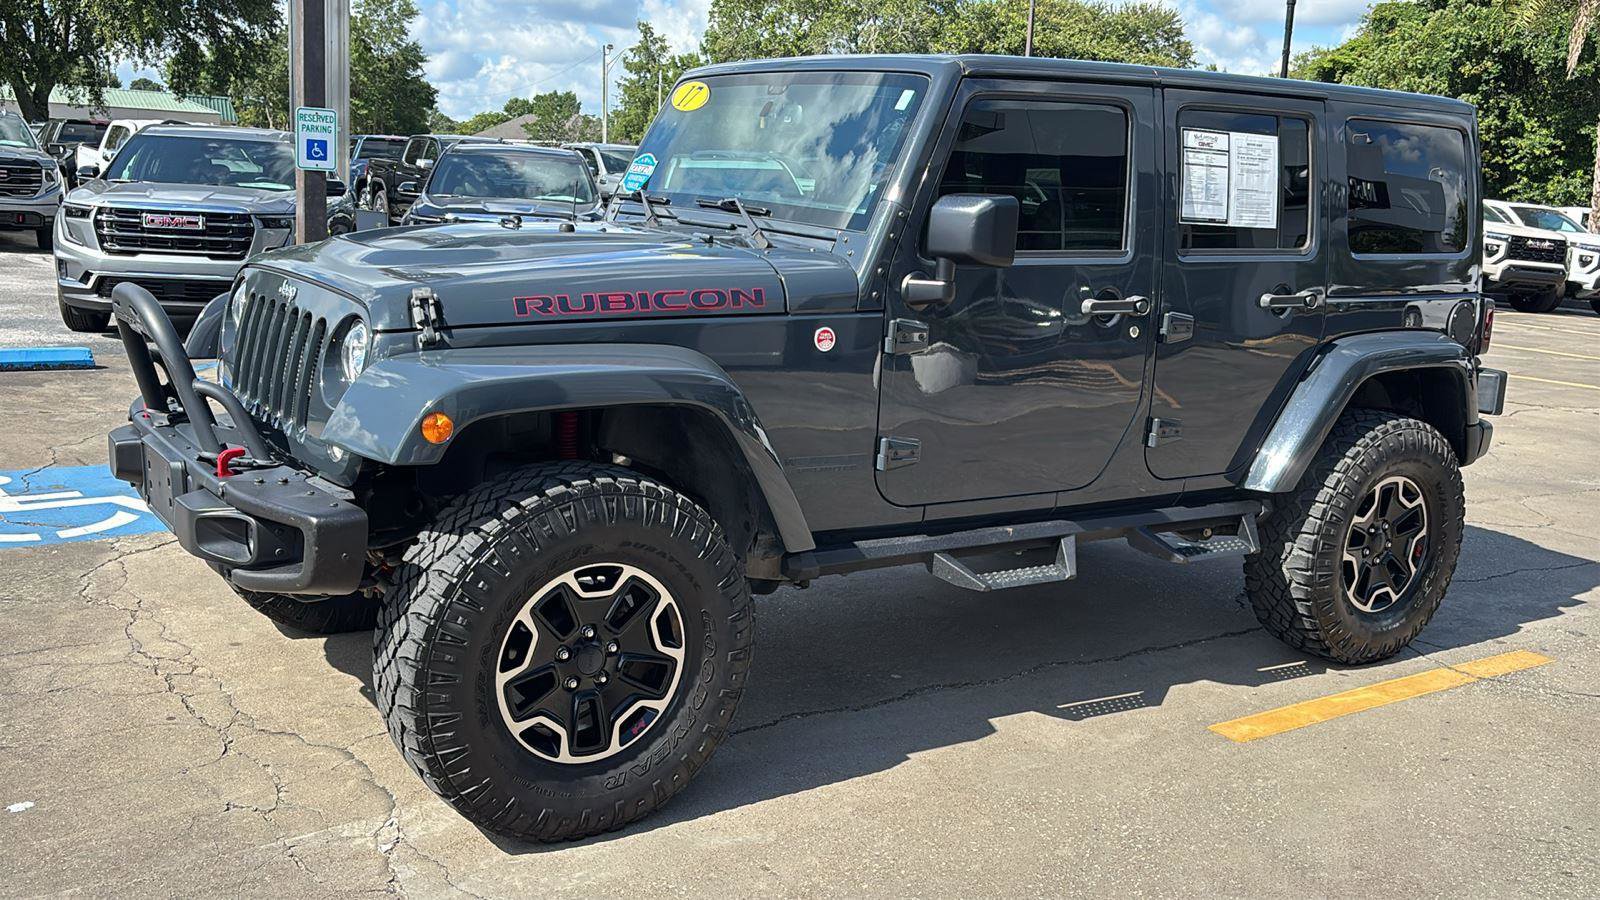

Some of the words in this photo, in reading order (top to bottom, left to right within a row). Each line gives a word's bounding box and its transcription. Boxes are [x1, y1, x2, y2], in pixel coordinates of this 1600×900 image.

[676, 85, 704, 109] 17
[299, 113, 335, 124] RESERVED
[301, 124, 333, 134] PARKING
[146, 215, 200, 229] GMC
[279, 280, 297, 302] Jeep
[512, 287, 767, 318] RUBICON
